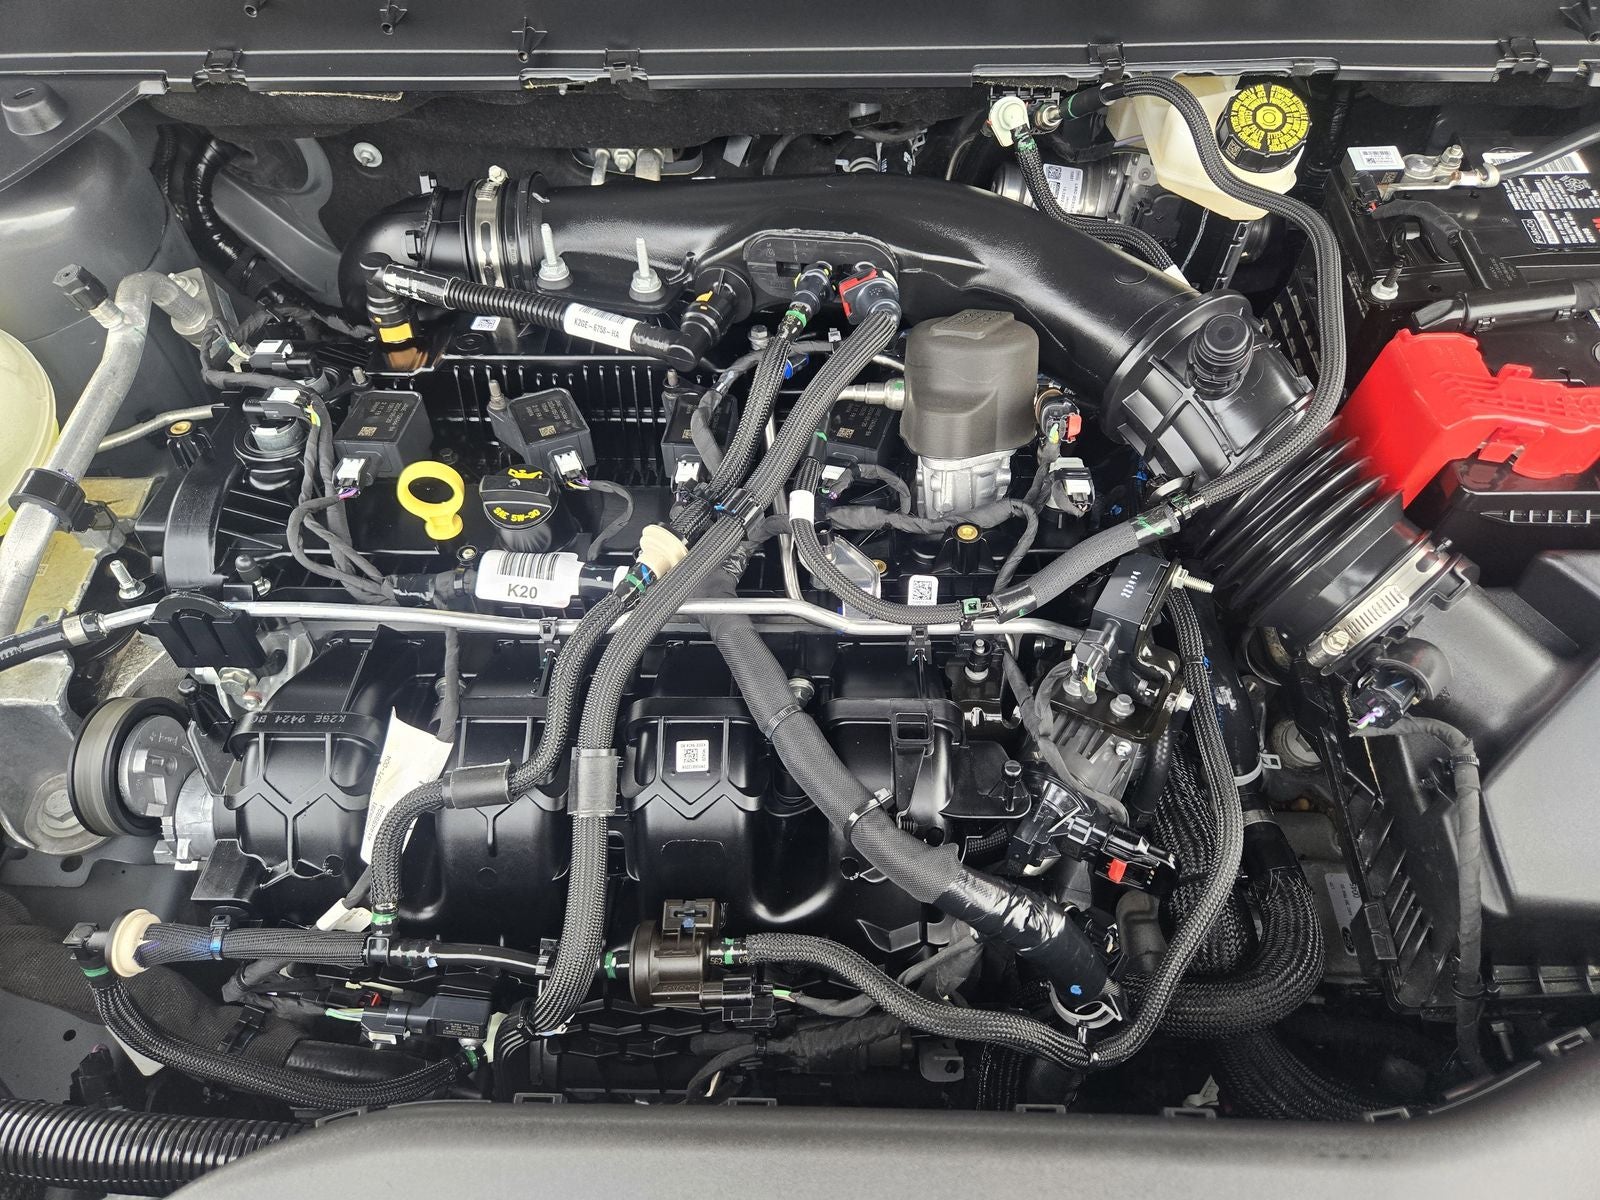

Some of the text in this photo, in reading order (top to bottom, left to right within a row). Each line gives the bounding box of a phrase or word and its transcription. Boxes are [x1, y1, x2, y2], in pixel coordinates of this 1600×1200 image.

[493, 506, 510, 520] SAE
[507, 583, 538, 599] K20
[274, 714, 307, 725] 9424
